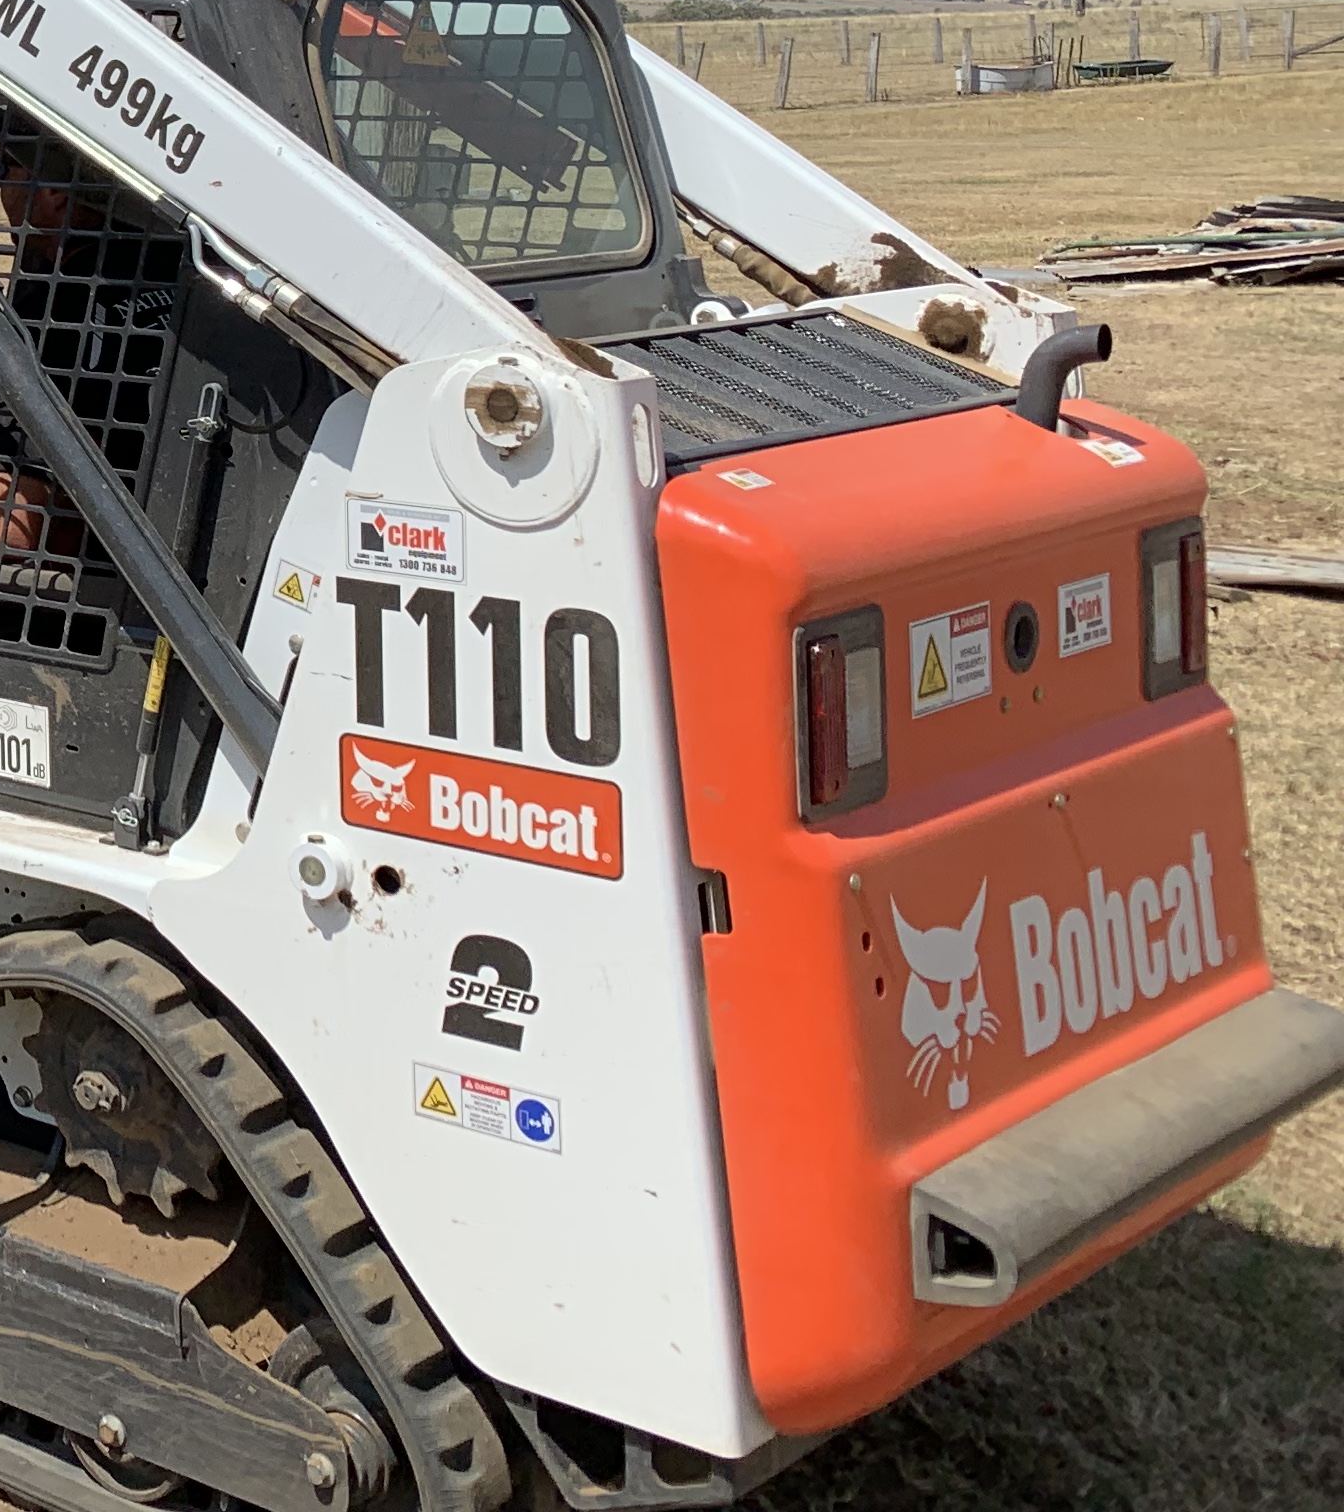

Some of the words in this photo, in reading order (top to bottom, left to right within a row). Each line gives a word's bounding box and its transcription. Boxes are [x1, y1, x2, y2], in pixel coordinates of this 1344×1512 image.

[68, 45, 206, 175] 499kg
[112, 289, 176, 320] NATH
[388, 522, 446, 551] clark
[399, 559, 419, 571] 1300
[336, 576, 621, 766] T110
[33, 762, 46, 779] dB
[429, 773, 599, 860] Bobcat
[1009, 831, 1225, 1057] Bobcat
[441, 934, 533, 1052] 2
[446, 977, 540, 1015] SPEED
[474, 1082, 507, 1097] DANGER
